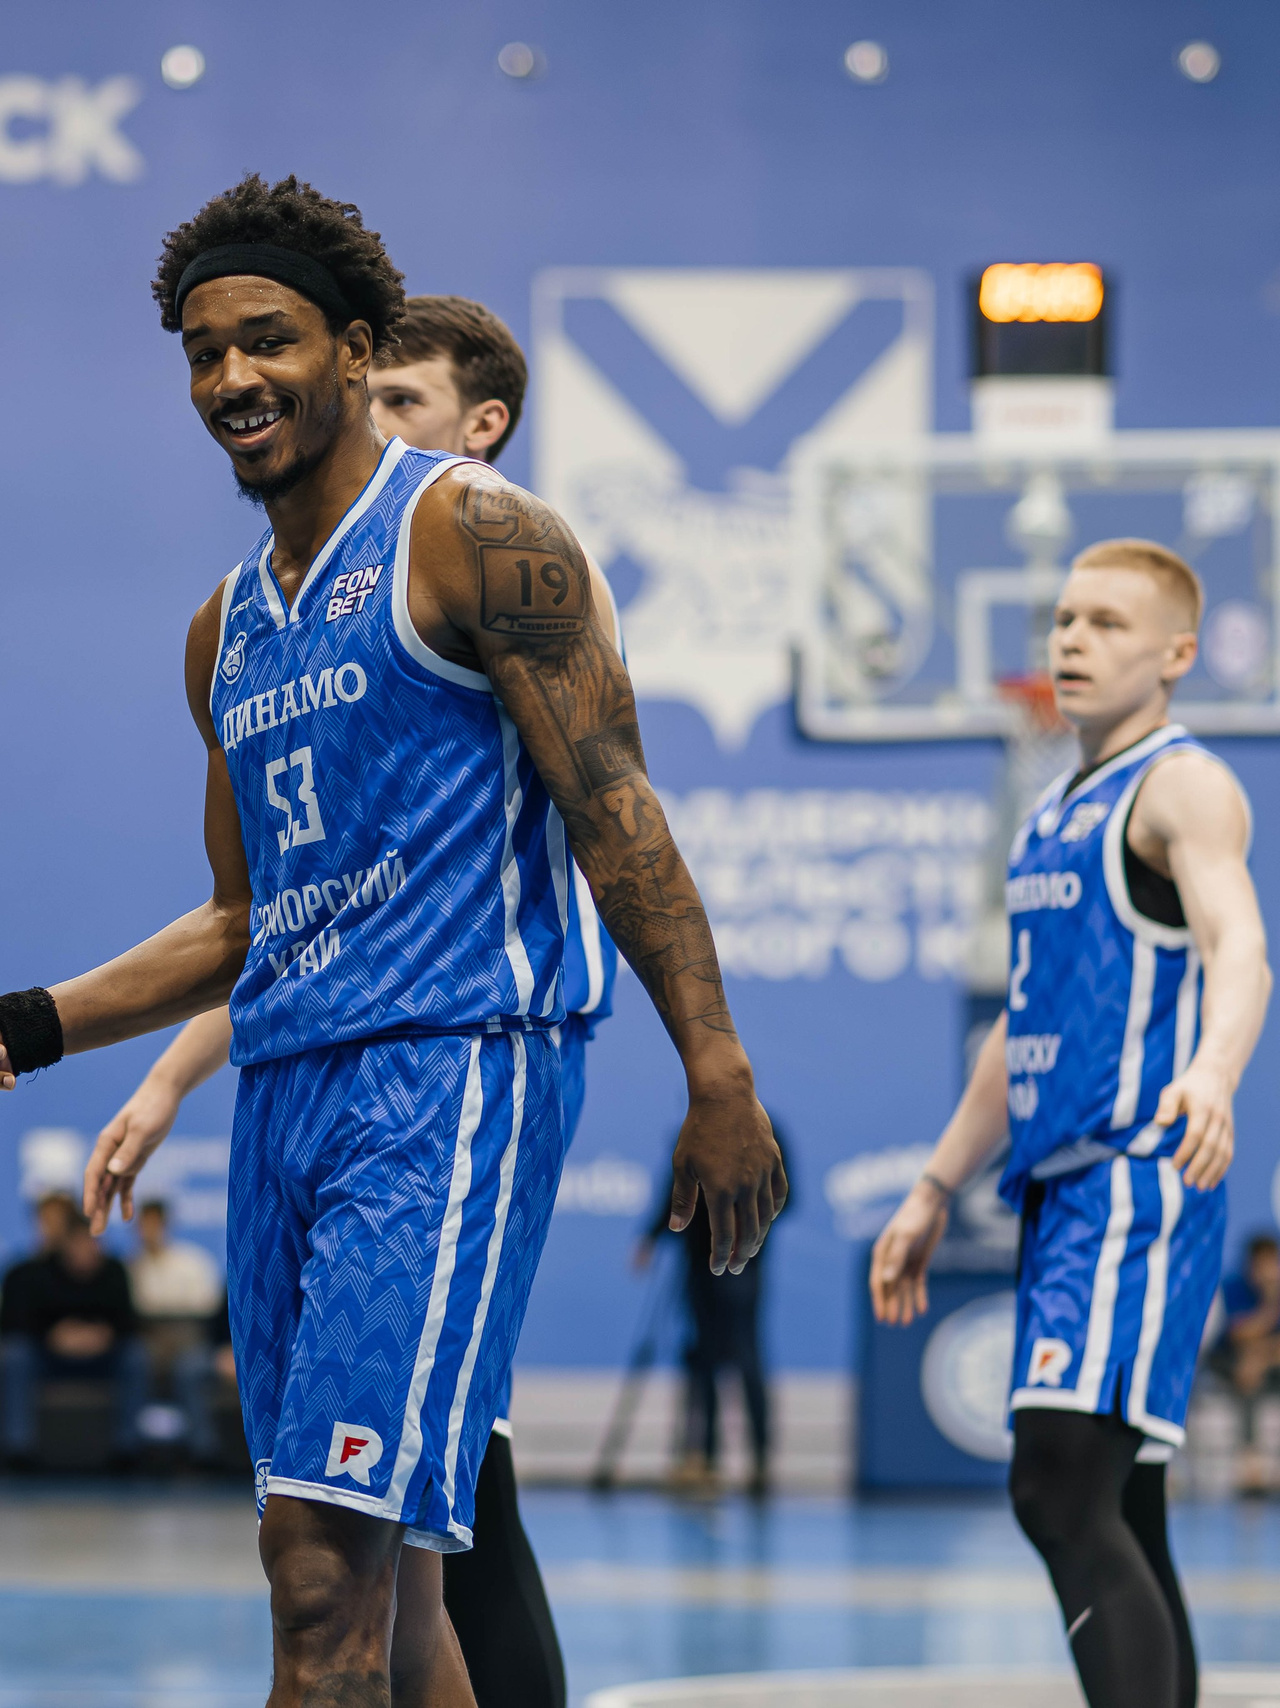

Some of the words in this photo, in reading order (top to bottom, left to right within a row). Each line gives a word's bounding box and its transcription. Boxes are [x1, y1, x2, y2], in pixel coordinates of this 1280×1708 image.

[331, 564, 384, 598] FON
[515, 559, 569, 607] 19
[325, 587, 373, 624] BET
[222, 662, 368, 756] ДИНАМО
[265, 746, 326, 857] 53
